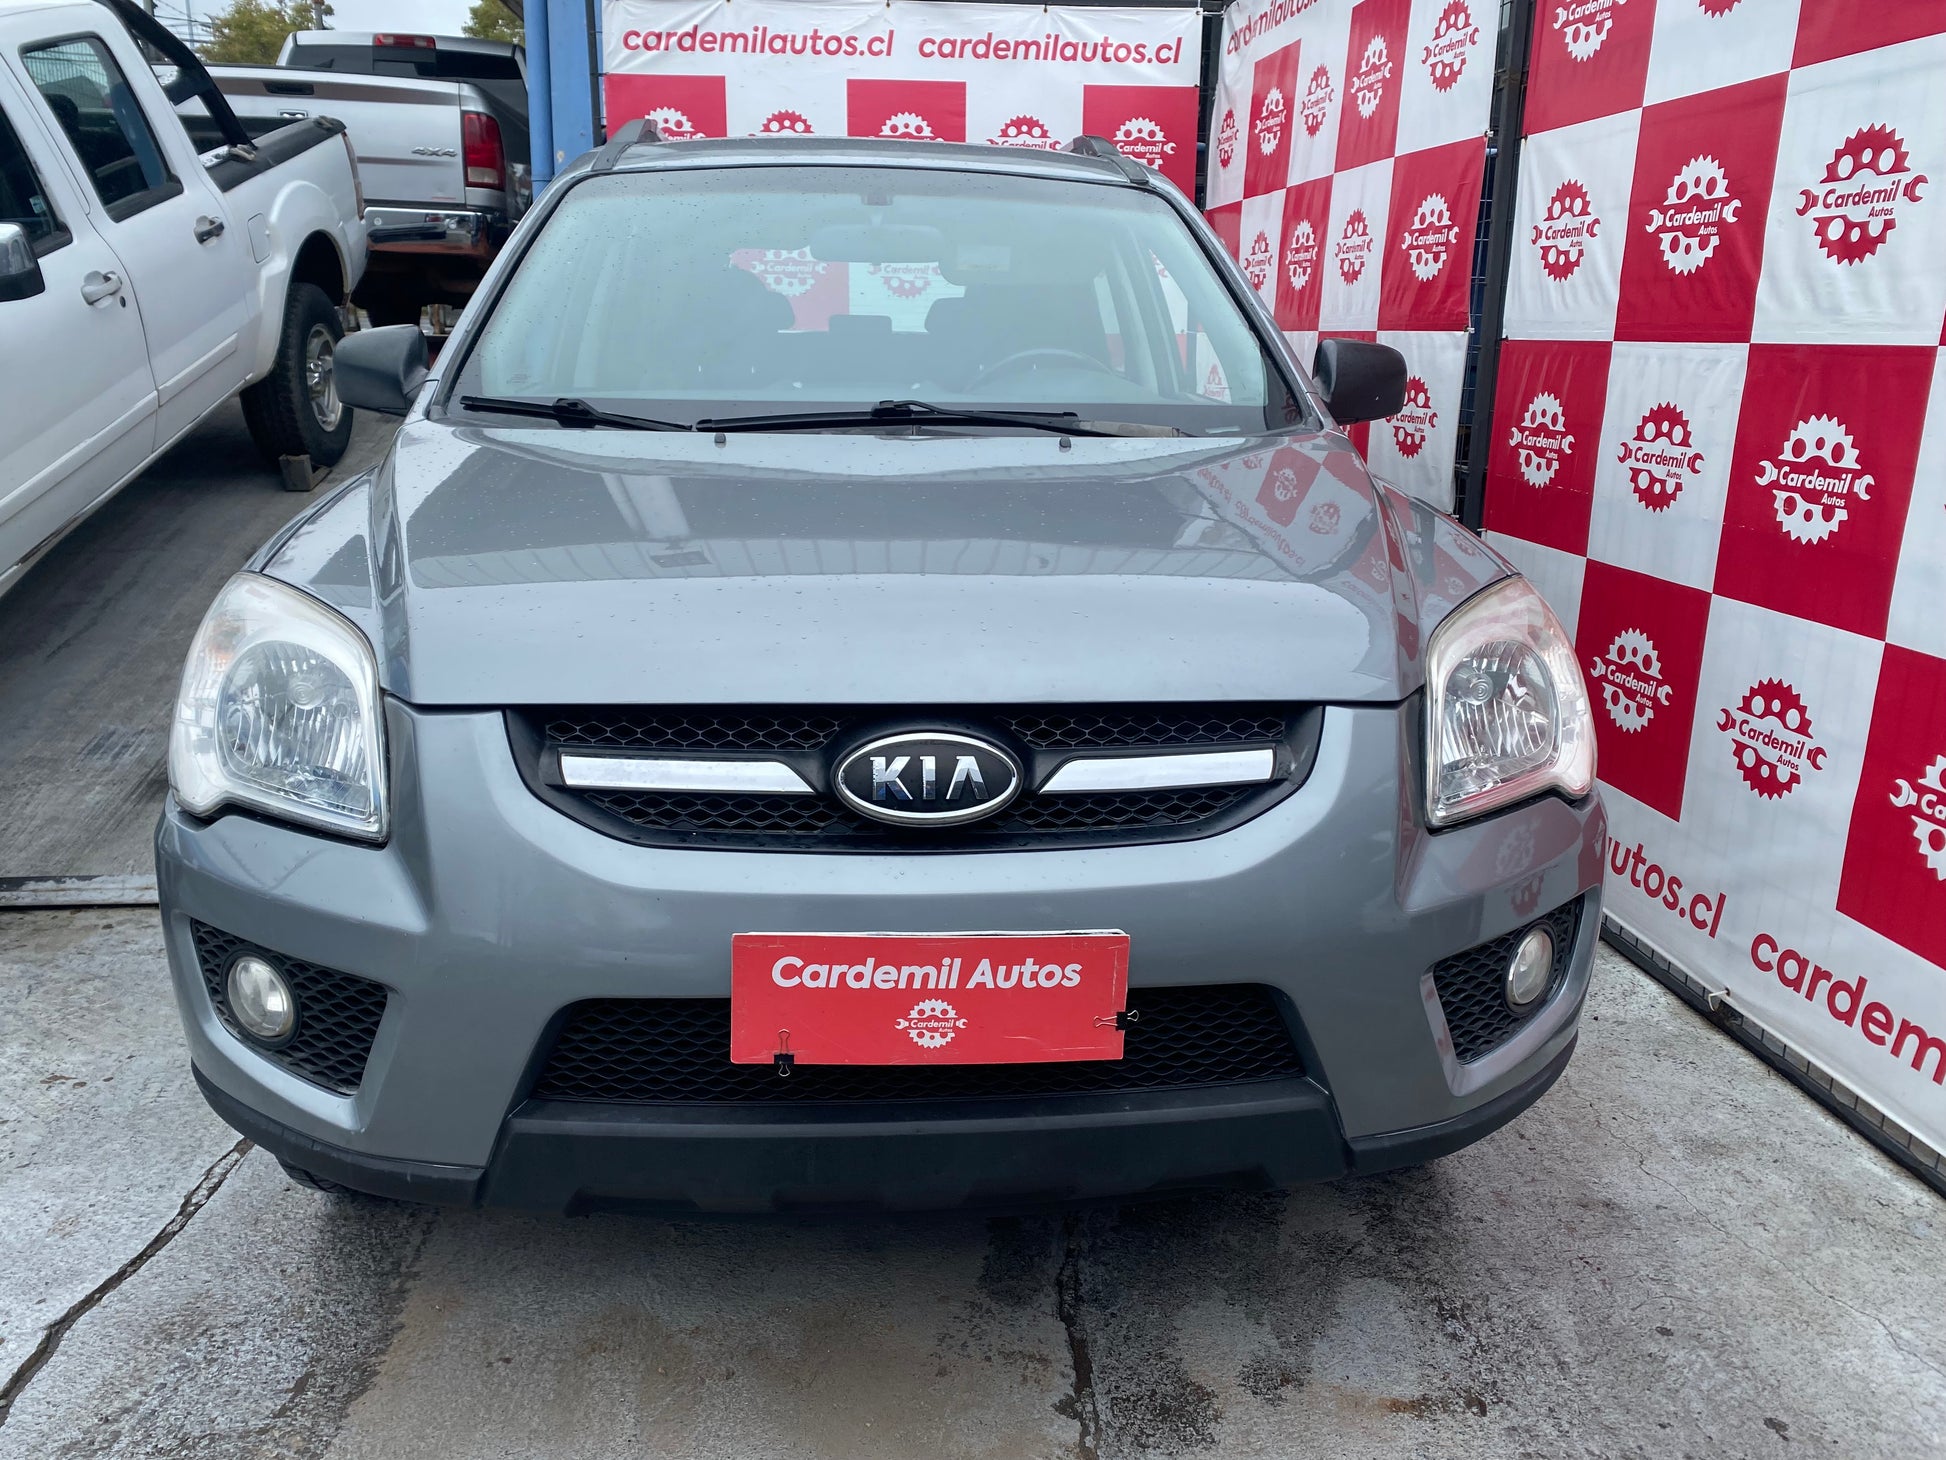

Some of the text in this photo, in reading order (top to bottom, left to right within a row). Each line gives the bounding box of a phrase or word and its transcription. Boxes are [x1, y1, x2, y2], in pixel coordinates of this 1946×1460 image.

[622, 24, 1183, 64] cardemilautos.cl cardemilautos.cl
[1433, 31, 1468, 57] Cardemil
[1117, 142, 1162, 153] Cardemil
[1823, 178, 1901, 209] Cardemil
[1666, 202, 1722, 227] Cardemil
[1868, 205, 1894, 218] Autos
[1413, 228, 1448, 246] Cardemil
[1544, 219, 1585, 241] Cardemil
[1698, 225, 1717, 235] Autos
[1522, 430, 1562, 450] Cardemil
[1634, 446, 1687, 470] Cardemil
[1665, 468, 1682, 480] Autos
[1778, 465, 1853, 495] Cardemil
[1821, 492, 1846, 507] Autos
[1607, 664, 1657, 697] Cardemil
[1635, 693, 1653, 708] Autos
[1738, 721, 1806, 760] Cardemil
[1776, 754, 1800, 772] Autos
[869, 755, 990, 800] KIA
[1607, 836, 1946, 1086] utos.cl cardem
[771, 956, 1083, 990] Cardemil Autos
[910, 1019, 955, 1028] Cardemil
